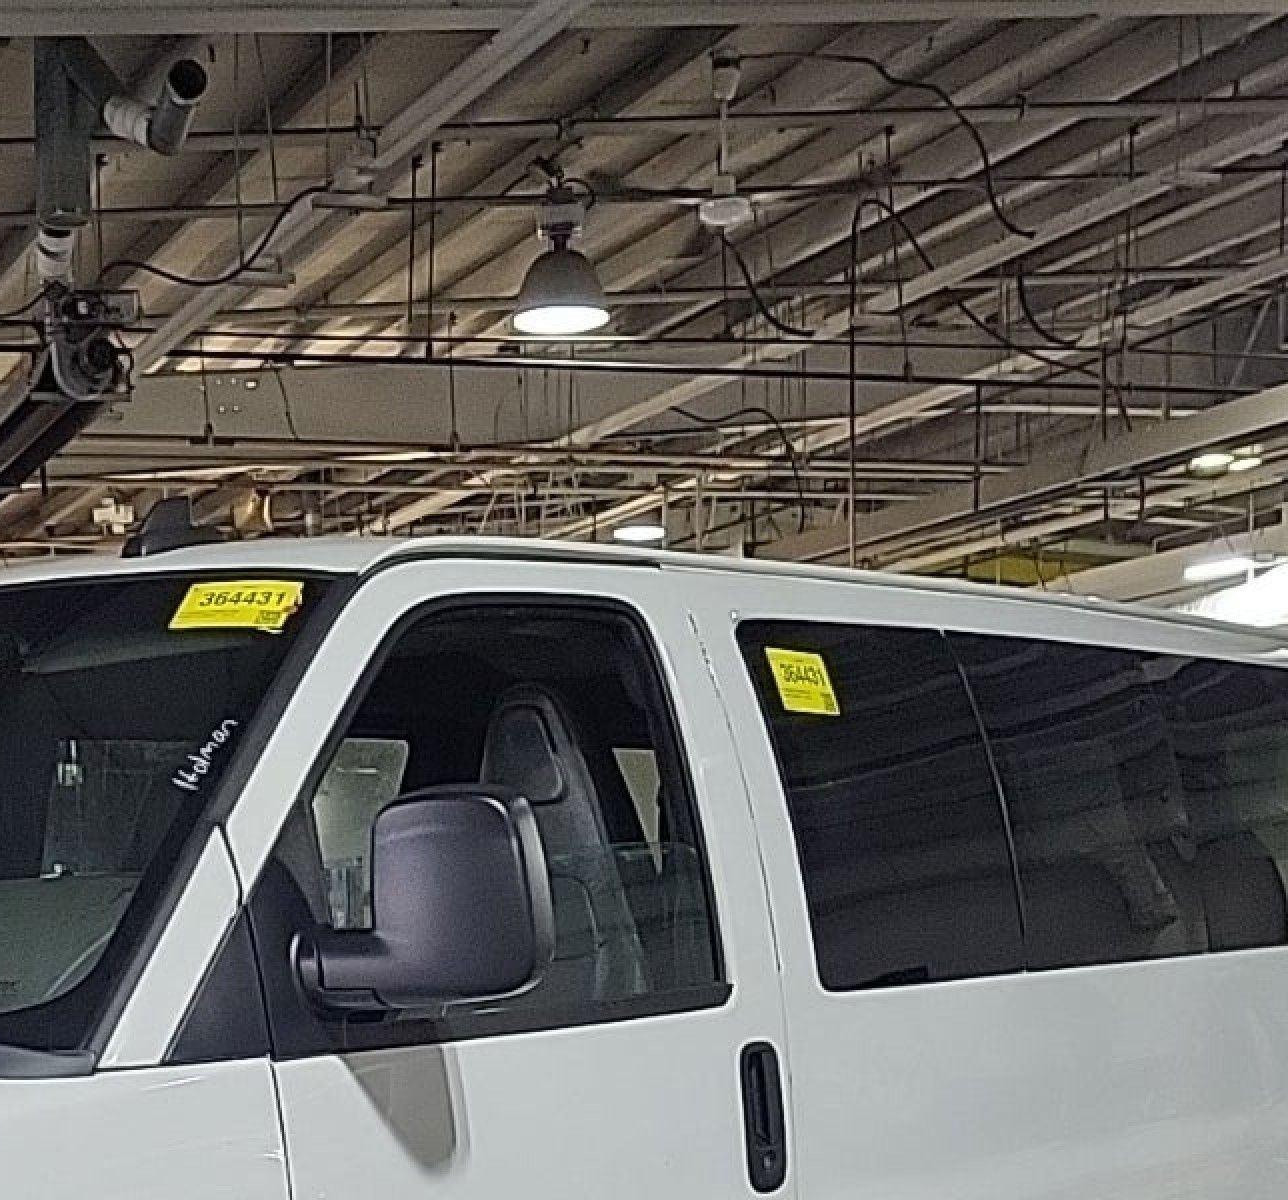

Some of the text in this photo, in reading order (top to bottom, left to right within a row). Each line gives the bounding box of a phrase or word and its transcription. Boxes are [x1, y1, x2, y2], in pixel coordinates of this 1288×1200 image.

[199, 591, 287, 607] 364431
[779, 663, 826, 687] 364431
[172, 719, 239, 791] Holman
